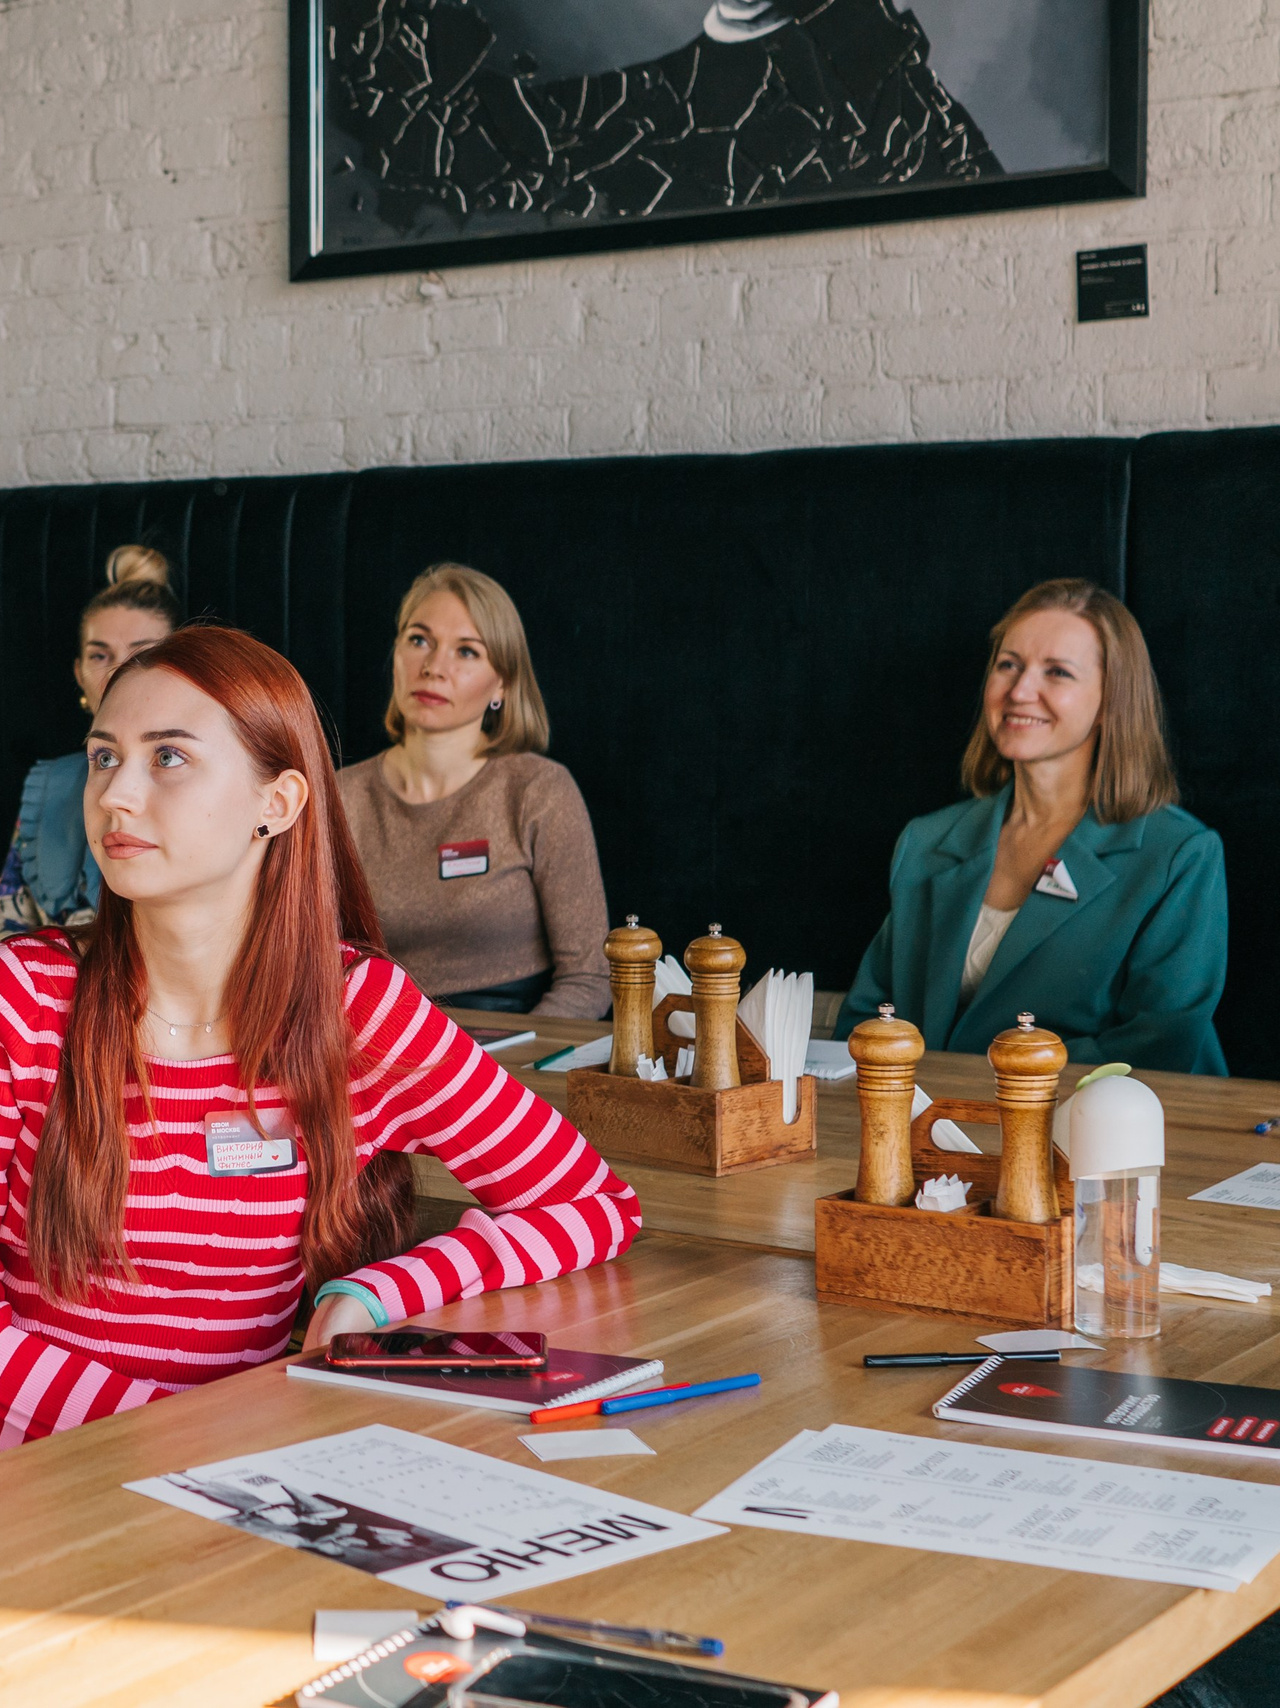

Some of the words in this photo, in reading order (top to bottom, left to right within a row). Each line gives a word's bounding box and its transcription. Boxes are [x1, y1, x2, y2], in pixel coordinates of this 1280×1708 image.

[217, 1126, 241, 1134] МОСКВЕ
[216, 1141, 264, 1153] ВИКТОРИЯ
[430, 1514, 671, 1582] МЕНЮ
